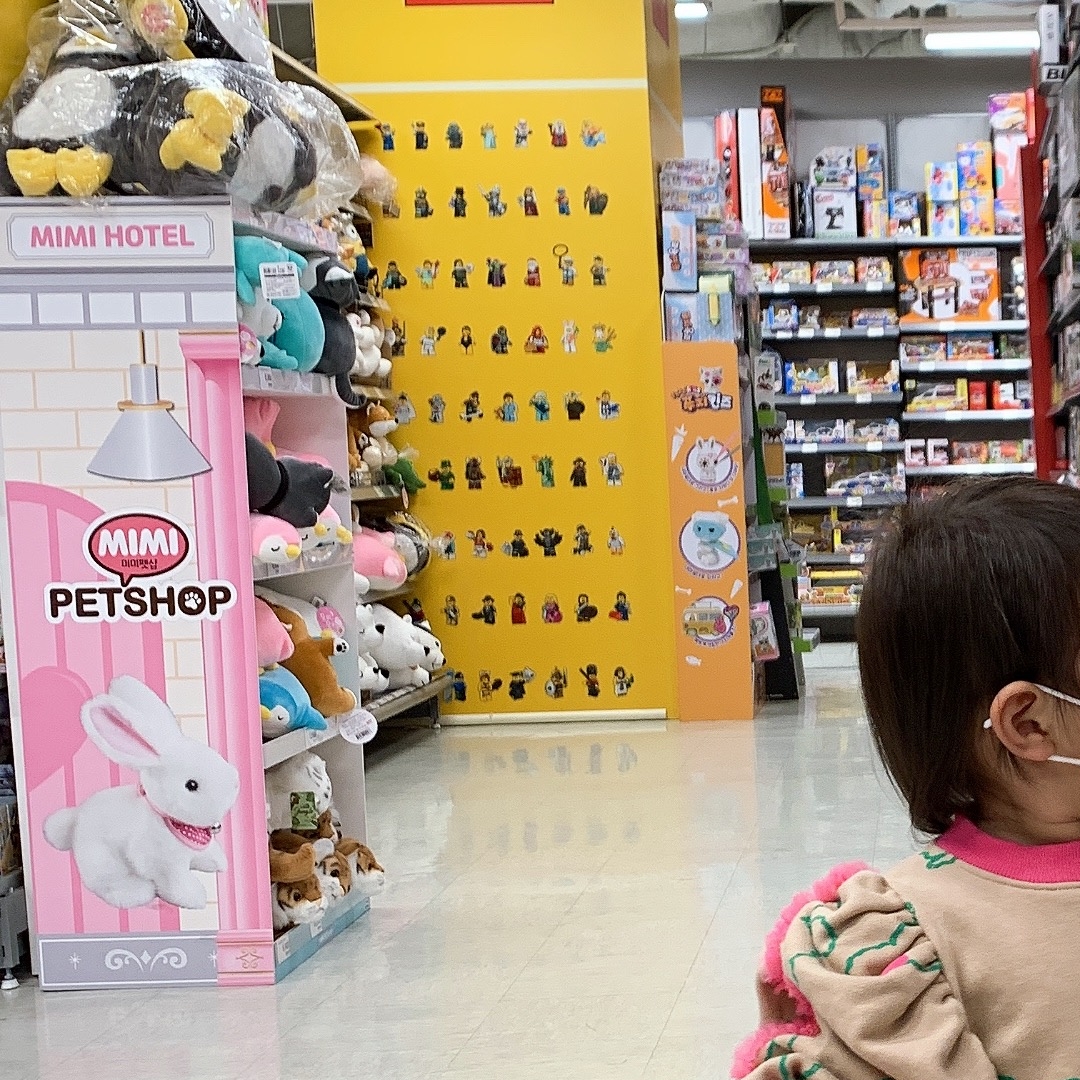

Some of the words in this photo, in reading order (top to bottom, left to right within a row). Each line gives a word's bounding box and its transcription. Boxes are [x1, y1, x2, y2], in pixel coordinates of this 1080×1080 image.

[30, 224, 97, 248] MIMI
[105, 223, 195, 248] HOTEL
[98, 526, 180, 557] MIMI
[50, 586, 234, 618] PETSHOP
